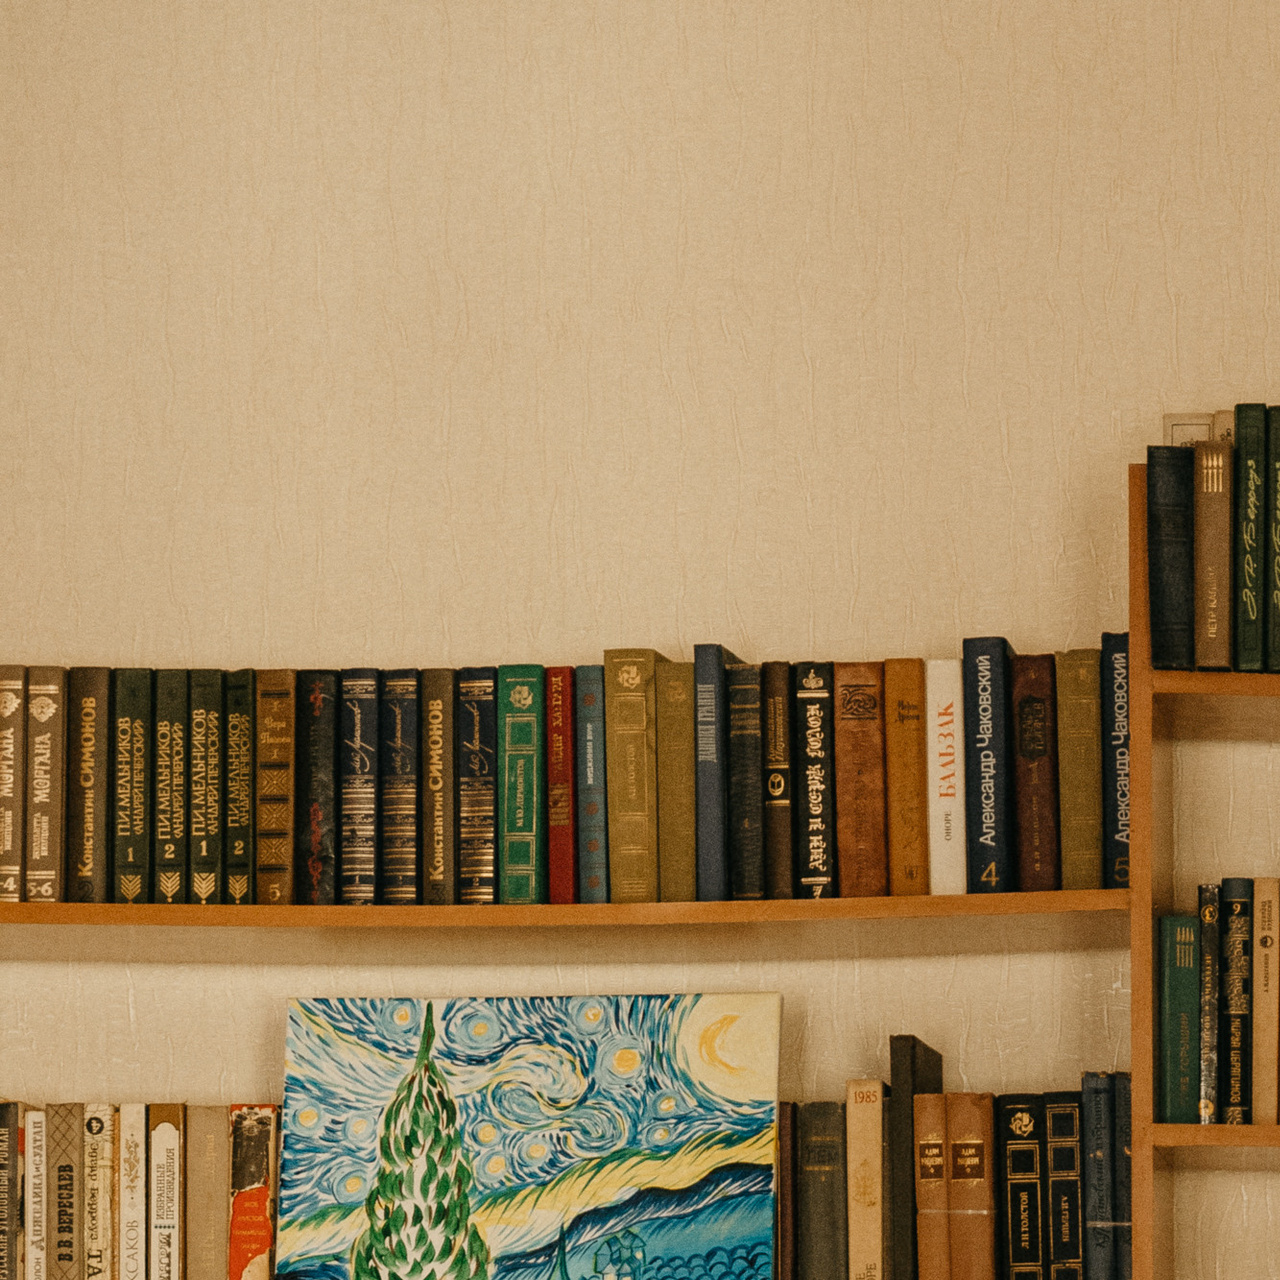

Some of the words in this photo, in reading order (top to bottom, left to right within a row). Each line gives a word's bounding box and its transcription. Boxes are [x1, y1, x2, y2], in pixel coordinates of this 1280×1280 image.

[975, 655, 992, 748] Чаковский
[82, 696, 96, 787] СИМОНОВ
[938, 700, 955, 799] БАЛЬЗАК
[977, 750, 996, 846] Александр
[79, 790, 94, 878] Константин
[164, 843, 175, 858] 2
[200, 840, 207, 855] 1
[981, 861, 999, 885] 4
[854, 1091, 877, 1103] 1985
[59, 1163, 74, 1234] ВЕРЕСАЕВ
[156, 1162, 164, 1220] ИЗБРАННЫЕ
[165, 1148, 175, 1220] ПРОИЗВЕДЕНИЯ
